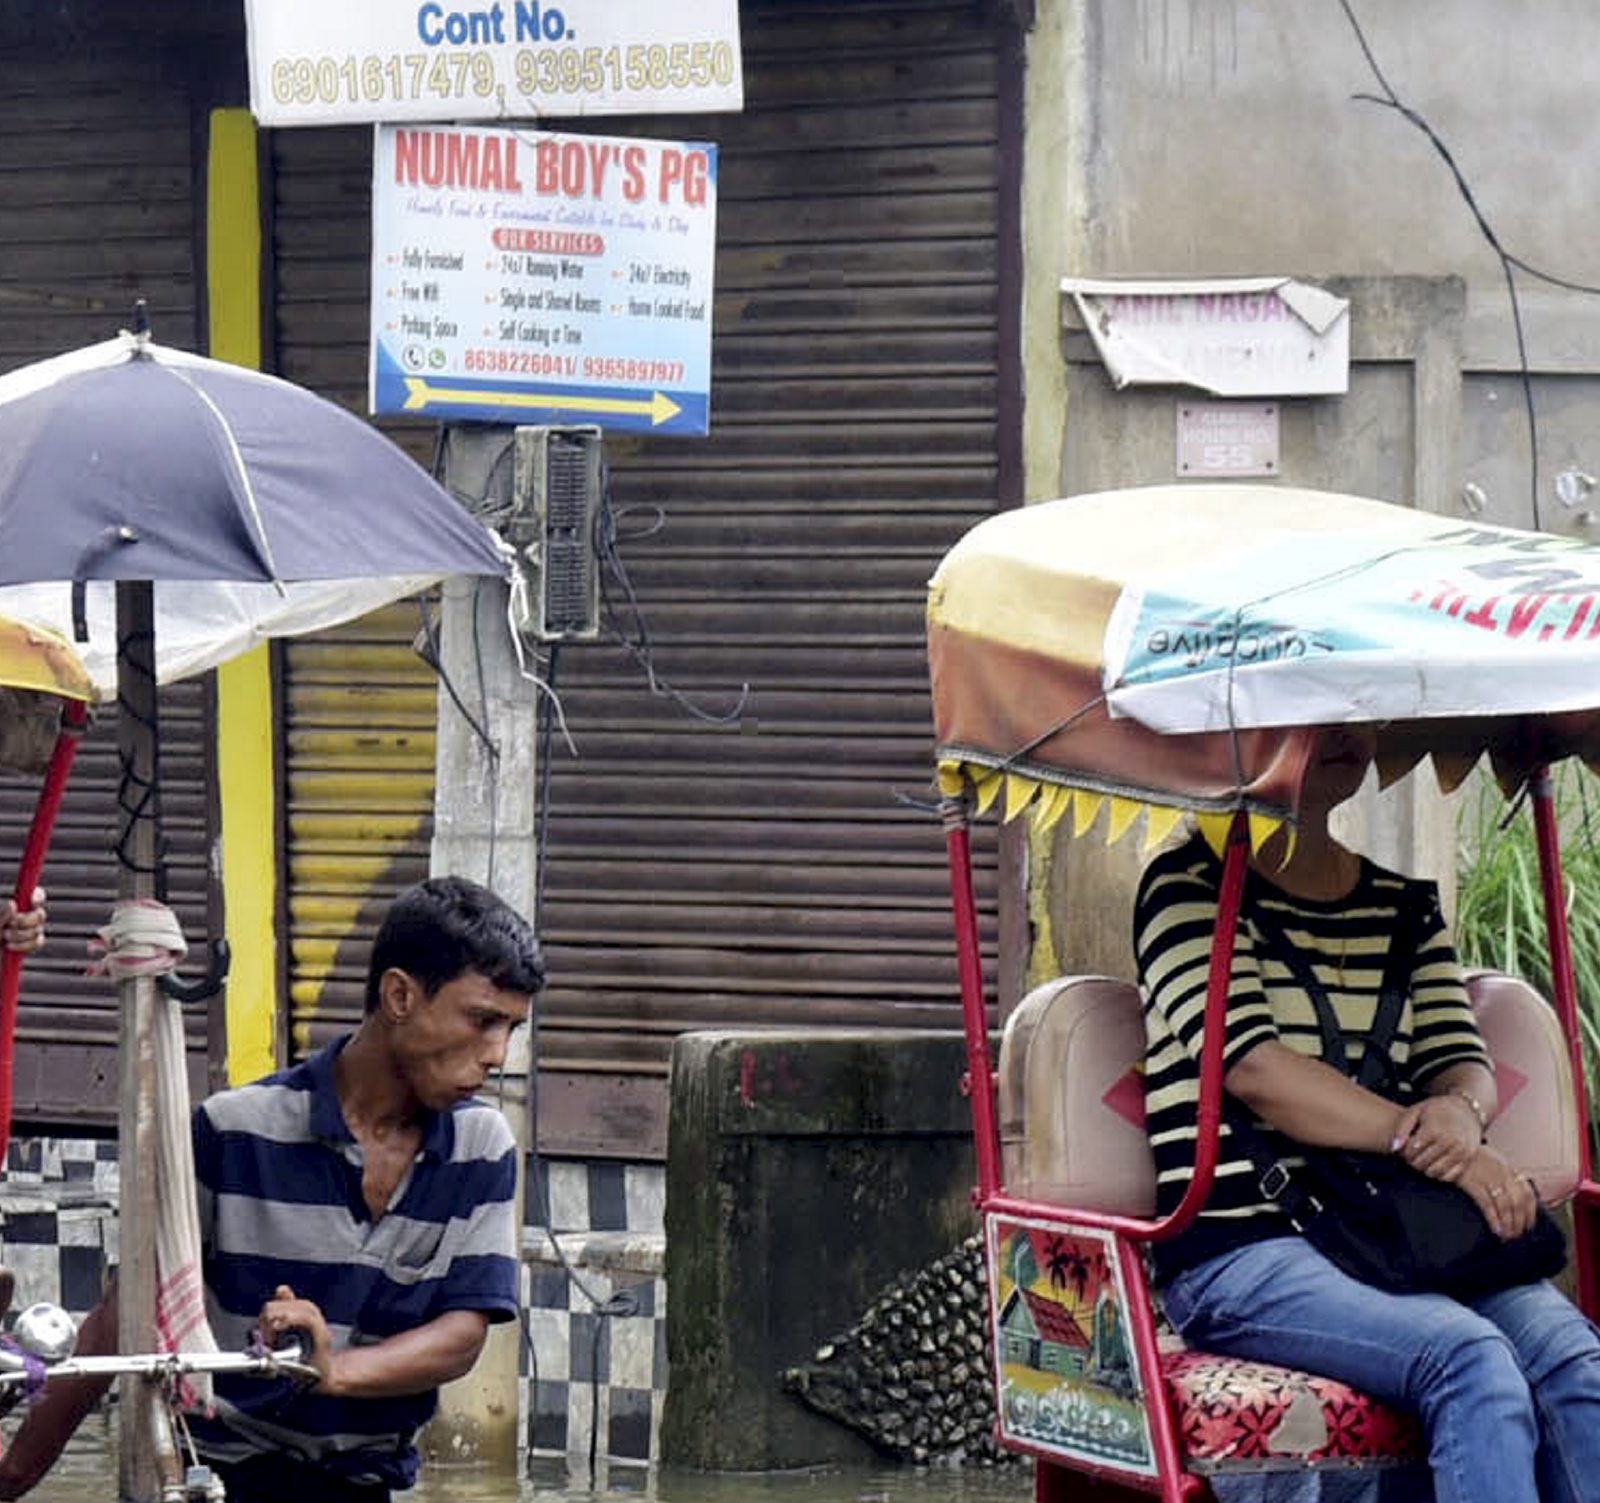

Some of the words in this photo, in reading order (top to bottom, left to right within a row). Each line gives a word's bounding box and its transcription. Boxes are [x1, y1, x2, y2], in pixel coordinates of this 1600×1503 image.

[417, 0, 504, 46] Cont
[515, 0, 575, 42] No.
[514, 40, 734, 94] 9395158550
[395, 130, 522, 194] NUMAL
[535, 139, 646, 203] BOY'S
[658, 148, 708, 208] PG
[533, 230, 598, 253] SERVICES
[653, 265, 691, 290] Electricity
[1195, 292, 1297, 322] NAGA
[401, 314, 432, 340] Parking
[434, 315, 458, 338] Space
[518, 321, 551, 347] Cooking
